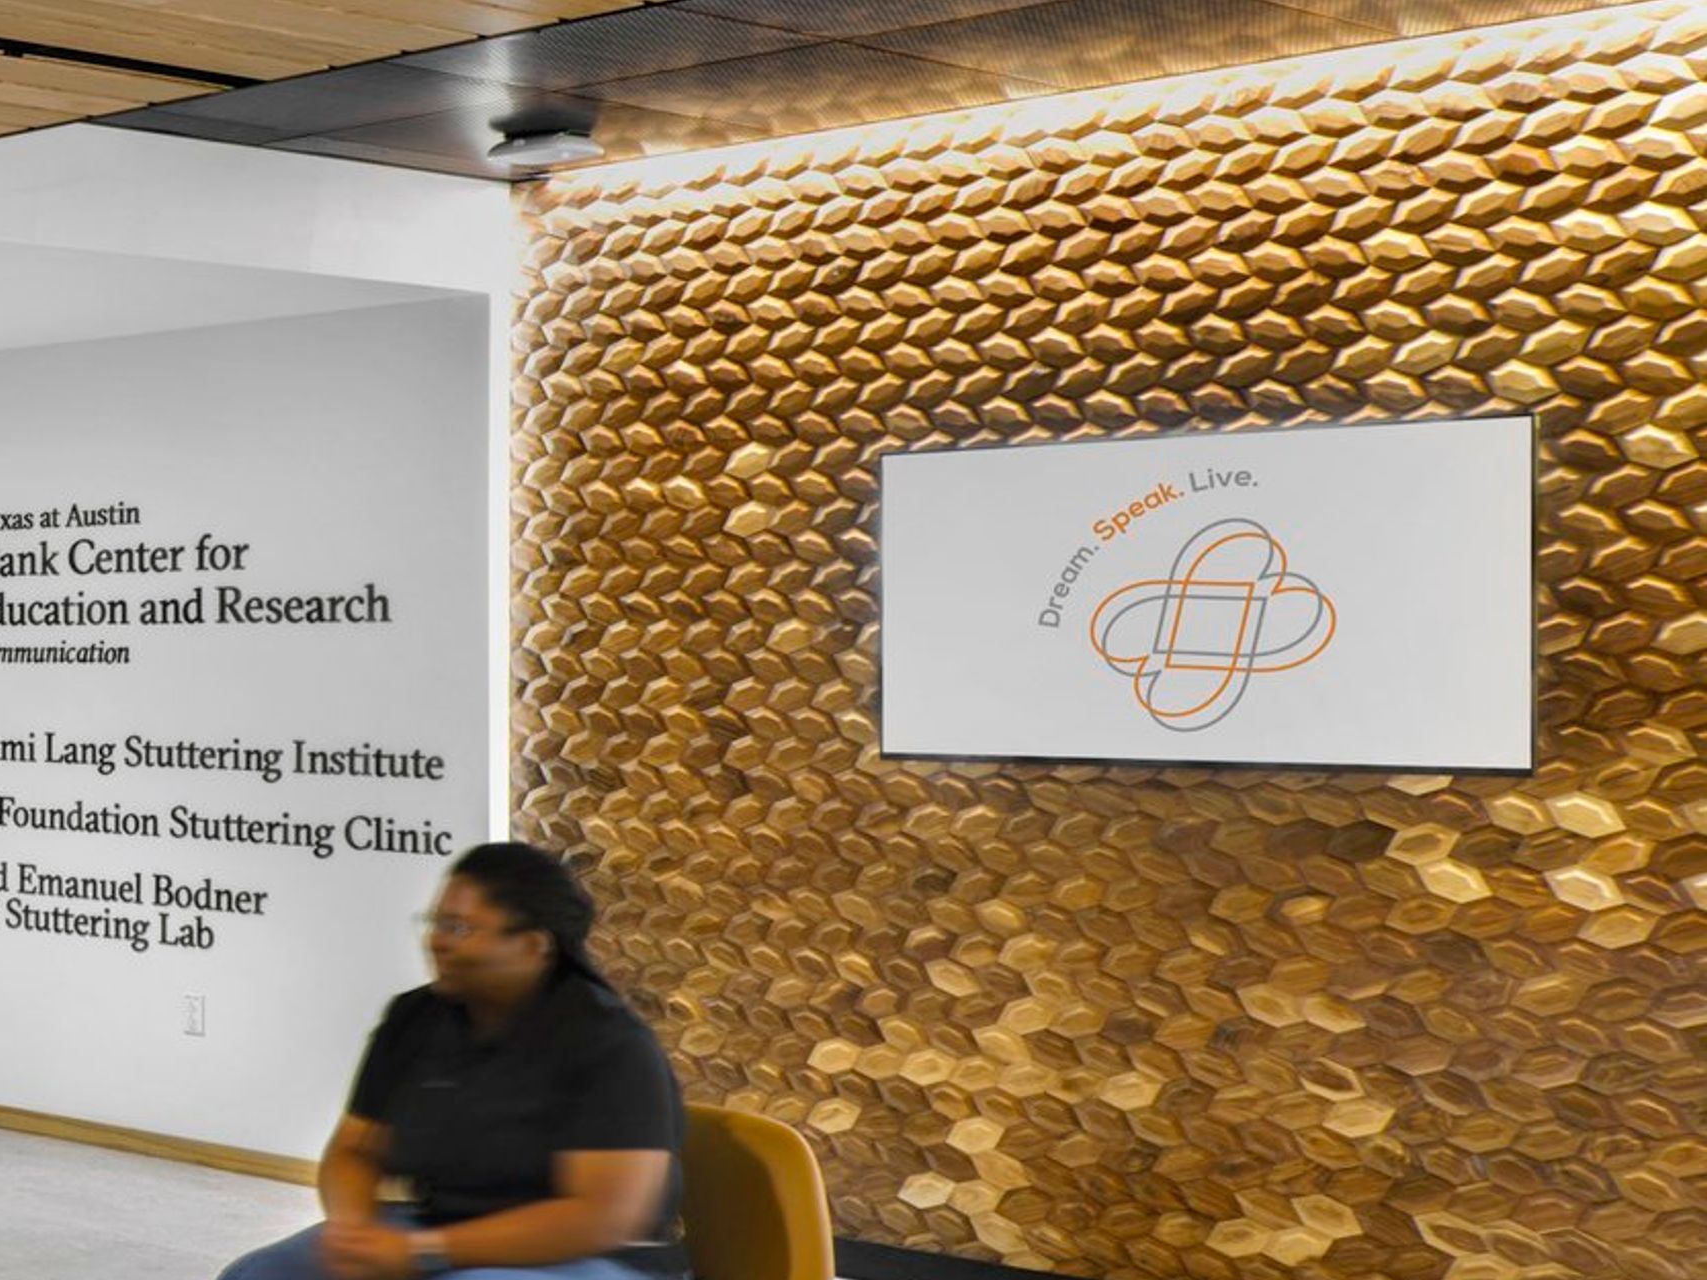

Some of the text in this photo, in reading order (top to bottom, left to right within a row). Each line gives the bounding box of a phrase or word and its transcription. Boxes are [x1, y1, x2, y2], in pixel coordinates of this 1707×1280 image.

[39, 508, 61, 529] at
[64, 500, 141, 528] Austin
[67, 538, 186, 576] Center
[194, 532, 250, 572] for
[1038, 467, 1259, 629] Dream. Speak. Live.
[138, 586, 206, 626] and
[214, 582, 393, 625] Research
[44, 731, 117, 776] Lang
[123, 734, 284, 784] Stuttering
[292, 739, 445, 781] Institute
[168, 804, 336, 860] Stuttering
[343, 814, 453, 857] Clinic
[17, 862, 144, 906] Emanuel
[151, 873, 269, 916] Bodner
[4, 896, 151, 954] Stuttering
[158, 911, 215, 950] Lab
